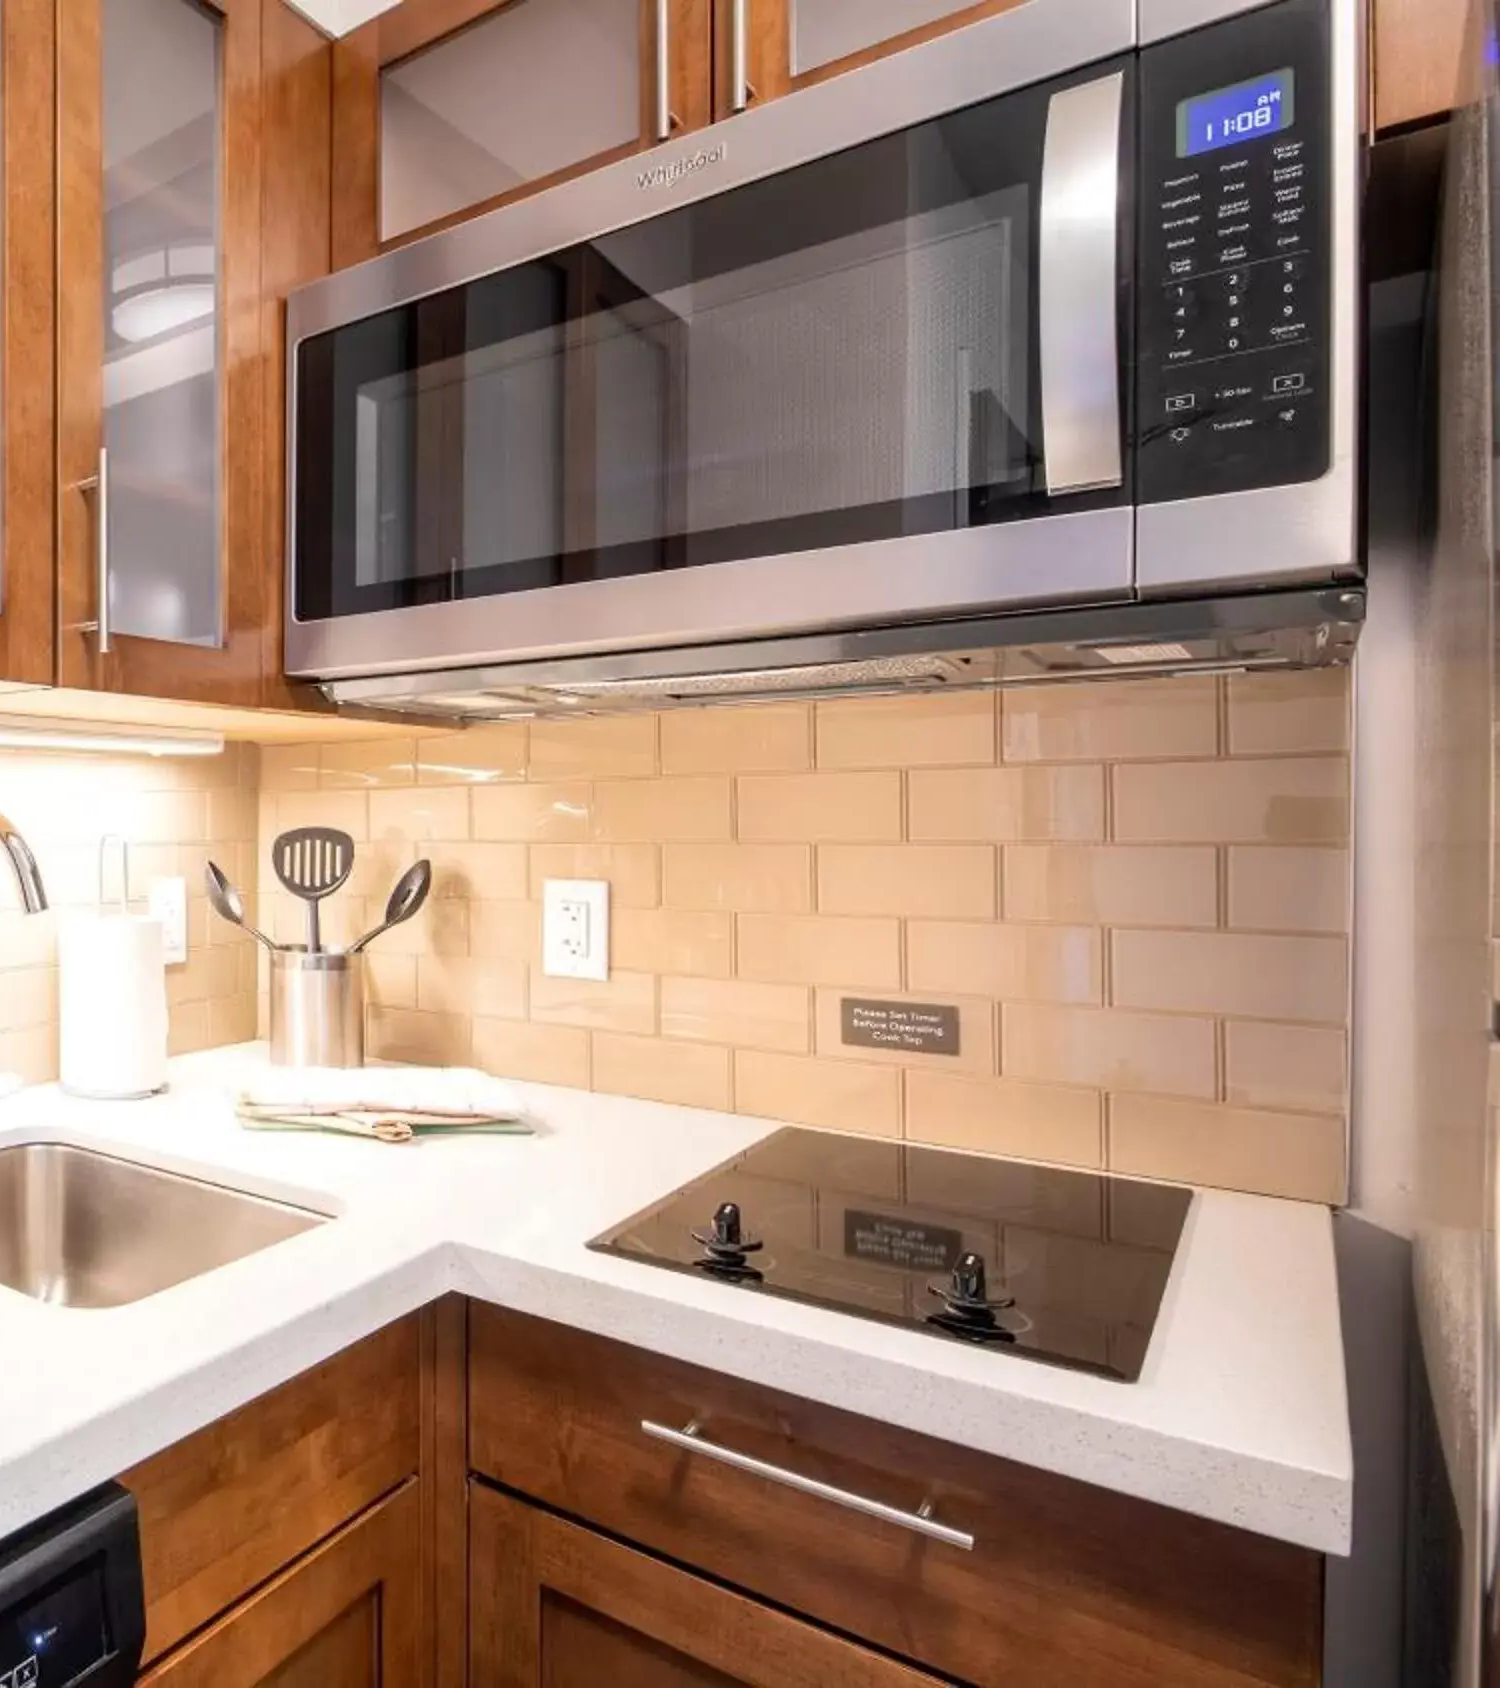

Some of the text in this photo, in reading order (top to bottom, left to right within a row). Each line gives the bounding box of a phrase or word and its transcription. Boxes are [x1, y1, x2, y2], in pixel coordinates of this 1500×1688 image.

[1257, 90, 1281, 106] AM
[1206, 105, 1271, 142] 11:08
[635, 141, 727, 189] Whirlpool
[853, 1008, 941, 1022] Please Set Timer
[853, 1018, 944, 1037] Before Operating
[871, 1031, 923, 1046] Cook Top
